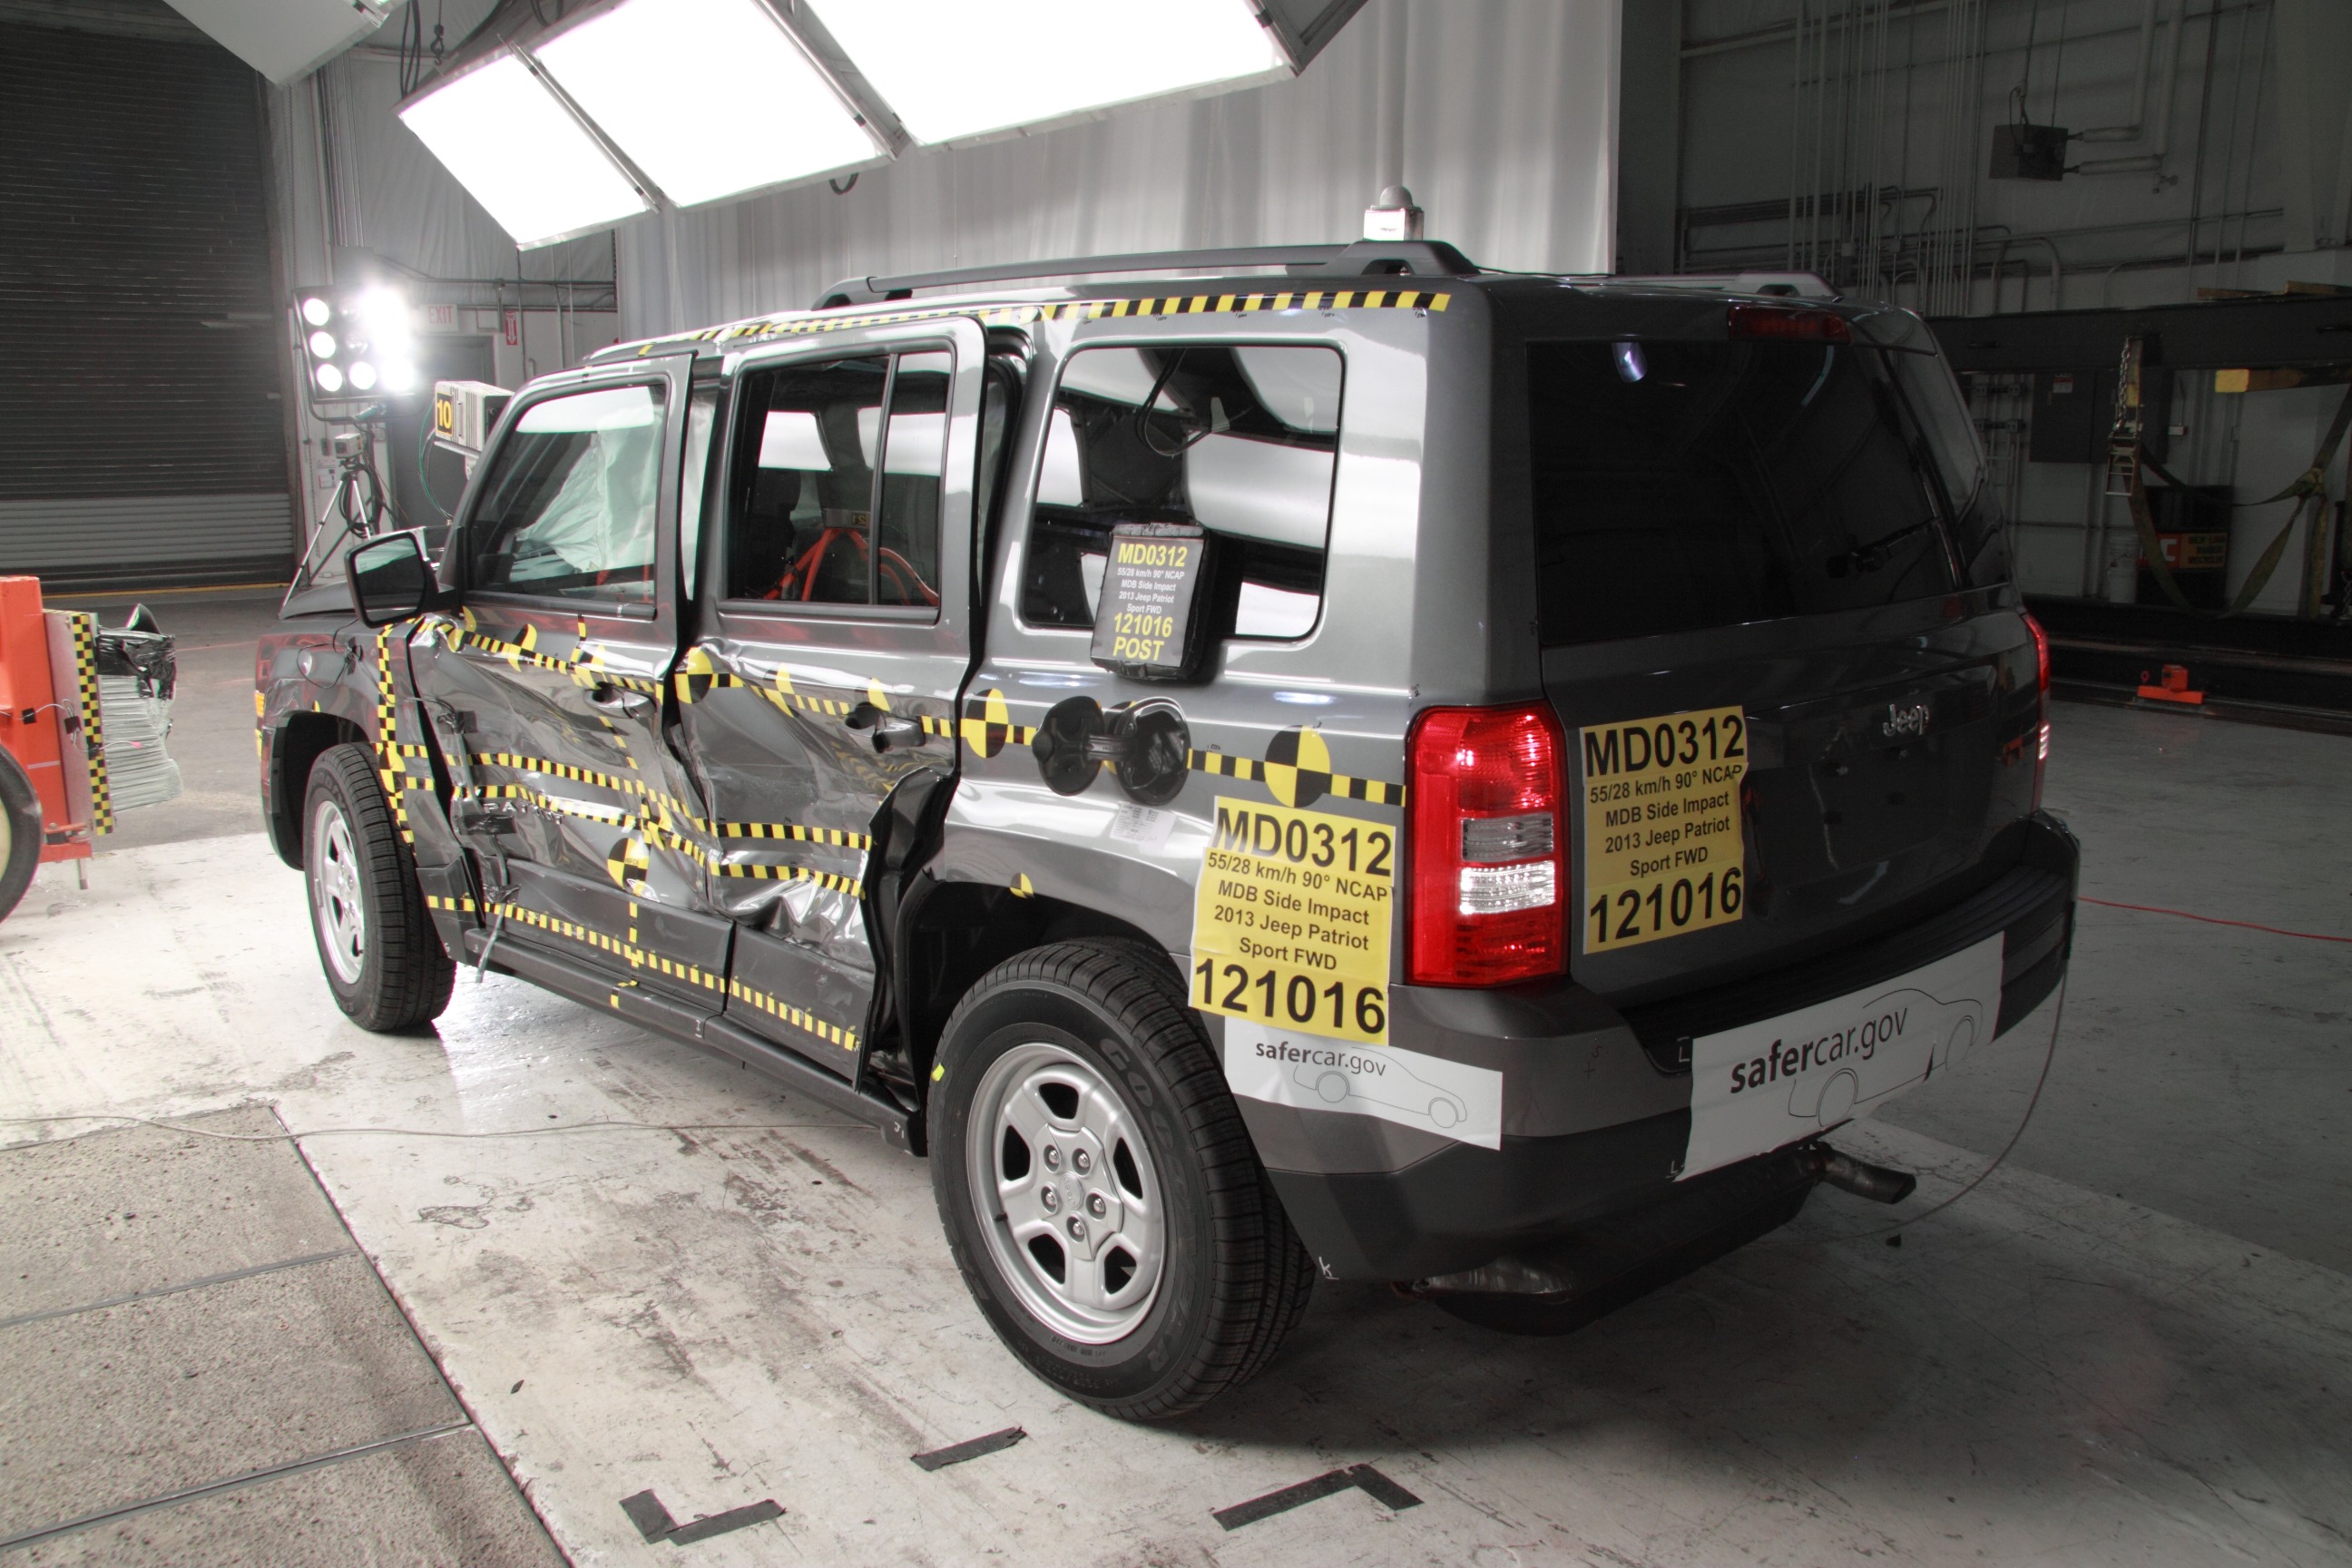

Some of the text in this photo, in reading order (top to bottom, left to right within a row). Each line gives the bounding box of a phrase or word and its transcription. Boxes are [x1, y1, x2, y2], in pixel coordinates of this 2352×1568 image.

[428, 305, 453, 324] EXIT
[436, 399, 452, 429] 10
[1118, 543, 1188, 567] MD0312
[1122, 580, 1176, 592] MDB Side Impact
[1136, 569, 1152, 578] km/h
[1165, 571, 1185, 580] NCAP
[1119, 592, 1174, 603] 2013 Jeep Patriot
[1127, 603, 1161, 614] Sport FWD
[1114, 612, 1172, 637] 121016
[1112, 637, 1164, 661] POST
[1882, 703, 1929, 737] Jeep
[1584, 714, 1745, 778] MD0312
[1590, 778, 1630, 804] 55/28
[1635, 774, 1671, 798] km/h
[1702, 764, 1742, 785] NCAP
[1605, 790, 1730, 828] MDB Side Impact
[1212, 807, 1392, 877] MD0312
[1605, 816, 1730, 854] 2013 Jeep Patriot
[1208, 852, 1387, 902] 55/28 km/h 90° NCAP
[1630, 846, 1708, 878] Sport FWD
[1218, 880, 1369, 926] MDB Side Impact
[1590, 867, 1742, 944] 121016
[1214, 905, 1368, 951] 2013 Jeep Patriot
[1240, 937, 1337, 970] Sport FWD
[1196, 958, 1386, 1034] 121016
[1255, 1041, 1387, 1076] safercar.gov
[1730, 1007, 1907, 1094] safercar.gov
